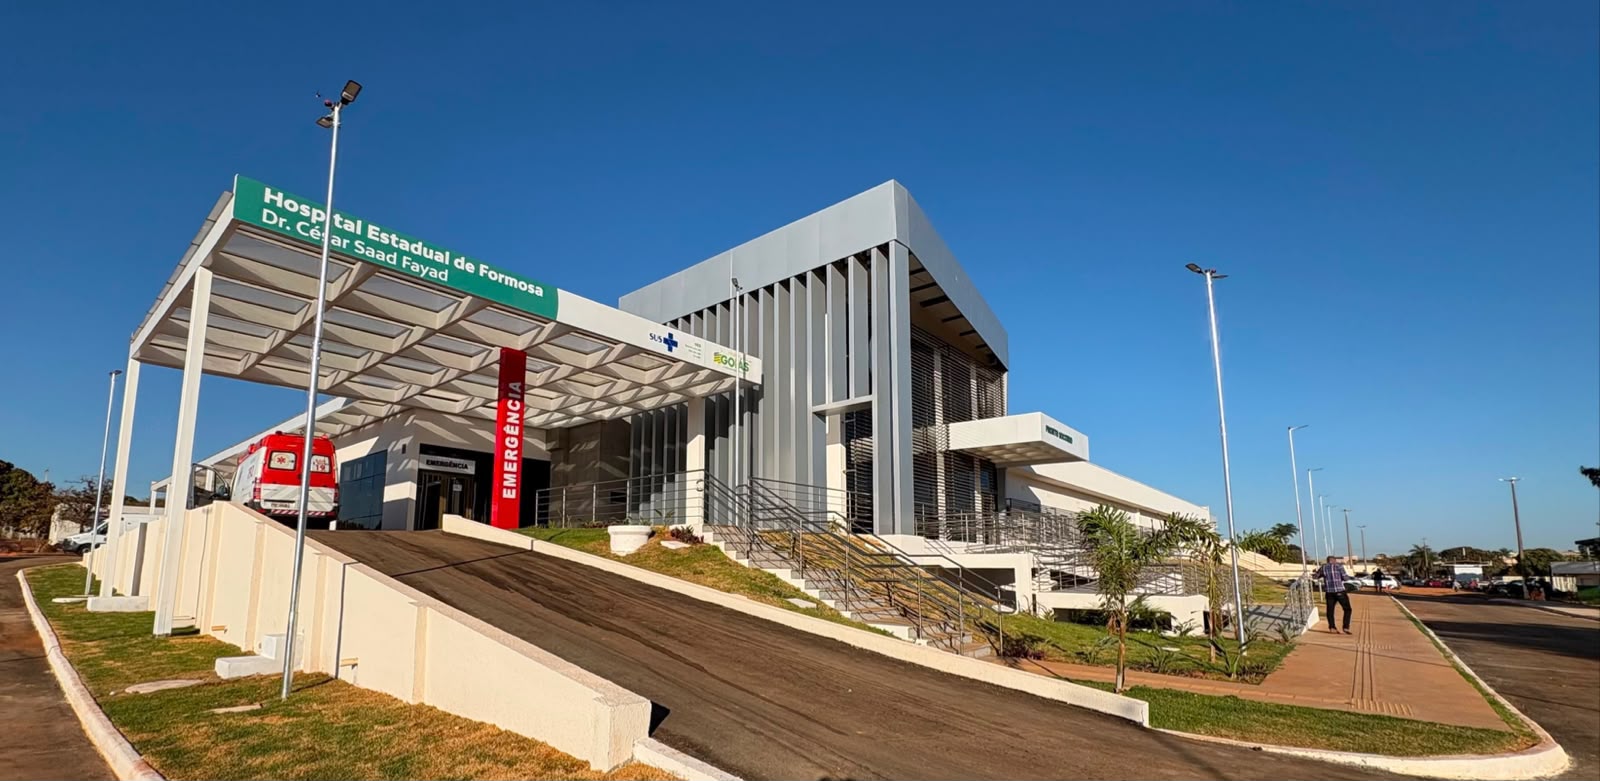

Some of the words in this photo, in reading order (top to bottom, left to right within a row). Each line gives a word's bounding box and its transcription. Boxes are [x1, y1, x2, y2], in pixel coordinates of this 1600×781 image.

[261, 208, 291, 231] Dr.
[354, 239, 398, 265] Saad
[402, 255, 449, 282] Fayad
[264, 187, 362, 235] Hosptal
[367, 224, 450, 265] Estadual
[453, 256, 475, 274] de
[479, 263, 544, 298] Formosa
[649, 332, 663, 344] SUS
[426, 459, 469, 470] EMERGÊNCIA
[502, 381, 522, 499] EMERGÊNCIA
